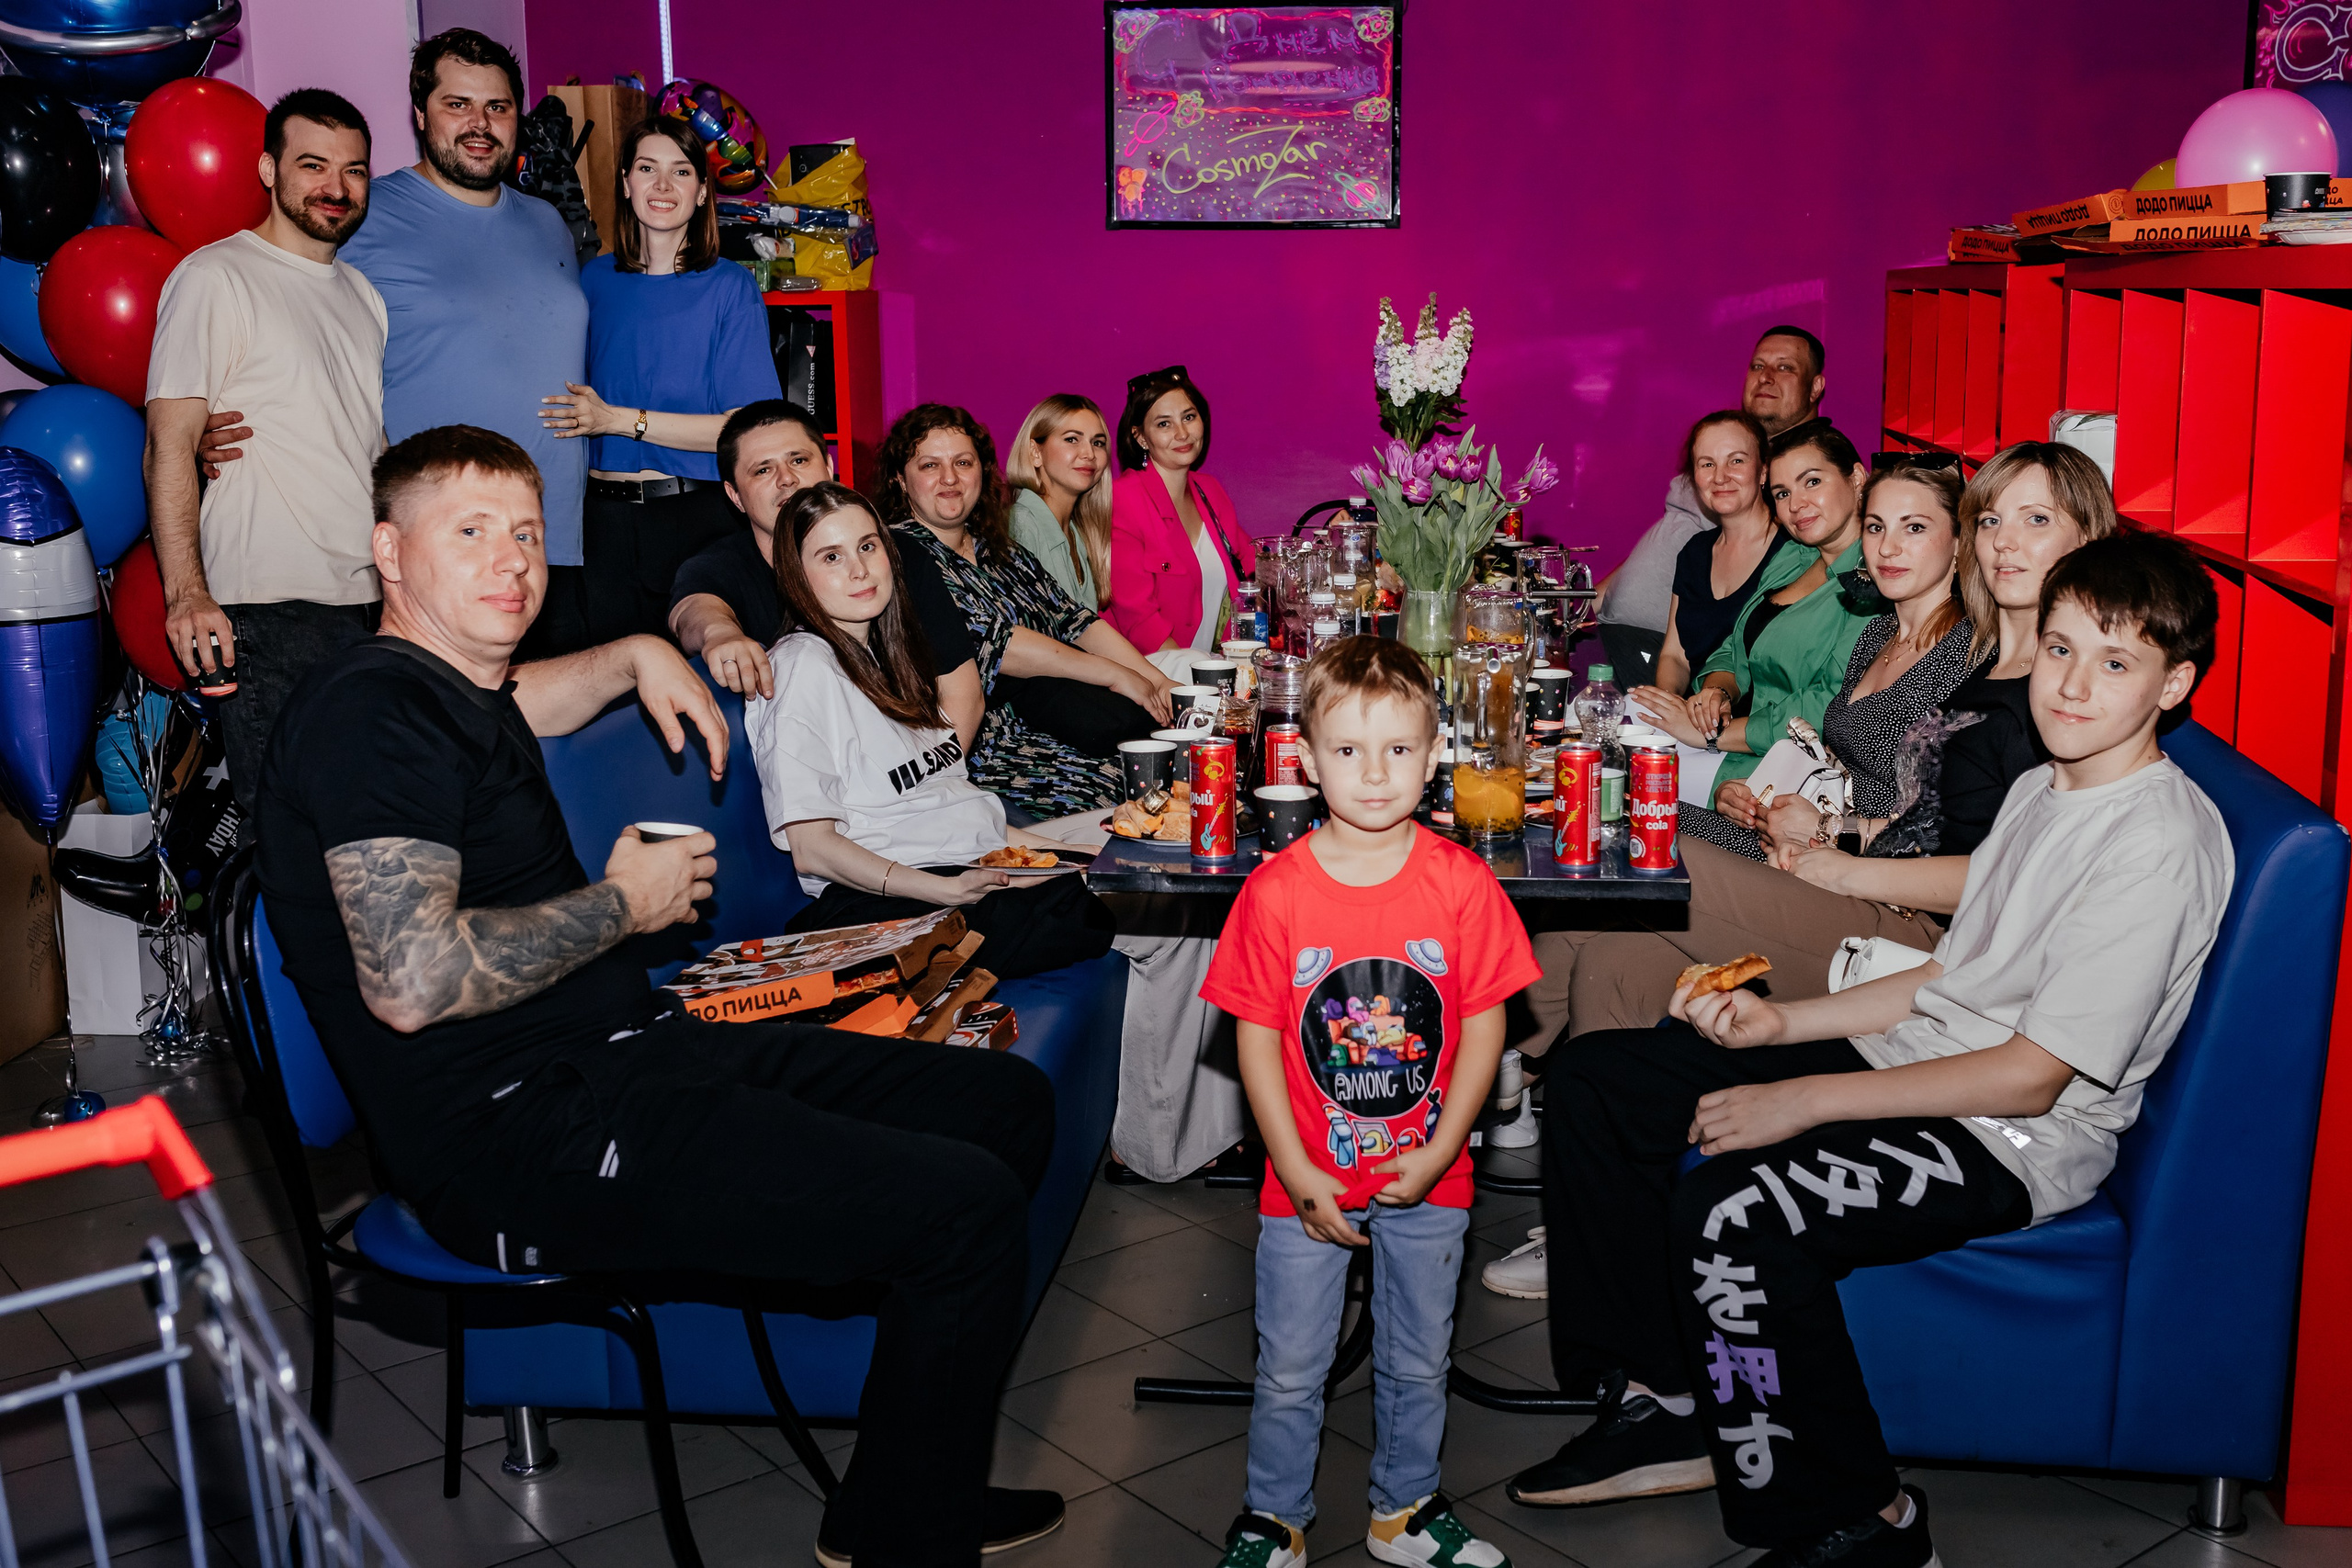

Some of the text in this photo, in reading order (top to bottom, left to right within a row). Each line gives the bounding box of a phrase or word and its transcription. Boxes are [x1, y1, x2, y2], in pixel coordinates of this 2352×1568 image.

[2062, 204, 2090, 223] ДОДО
[2136, 197, 2167, 215] ДОДО
[2169, 194, 2212, 213] ПИЦЦА
[2026, 211, 2062, 229] ПИЦЦА
[2134, 224, 2252, 241] ДОДО ПИЦЦА
[808, 362, 816, 415] GUESS.com
[1645, 820, 1668, 830] cola
[722, 987, 802, 1017] ПИЦЦА
[1335, 1065, 1425, 1102] AMONG US
